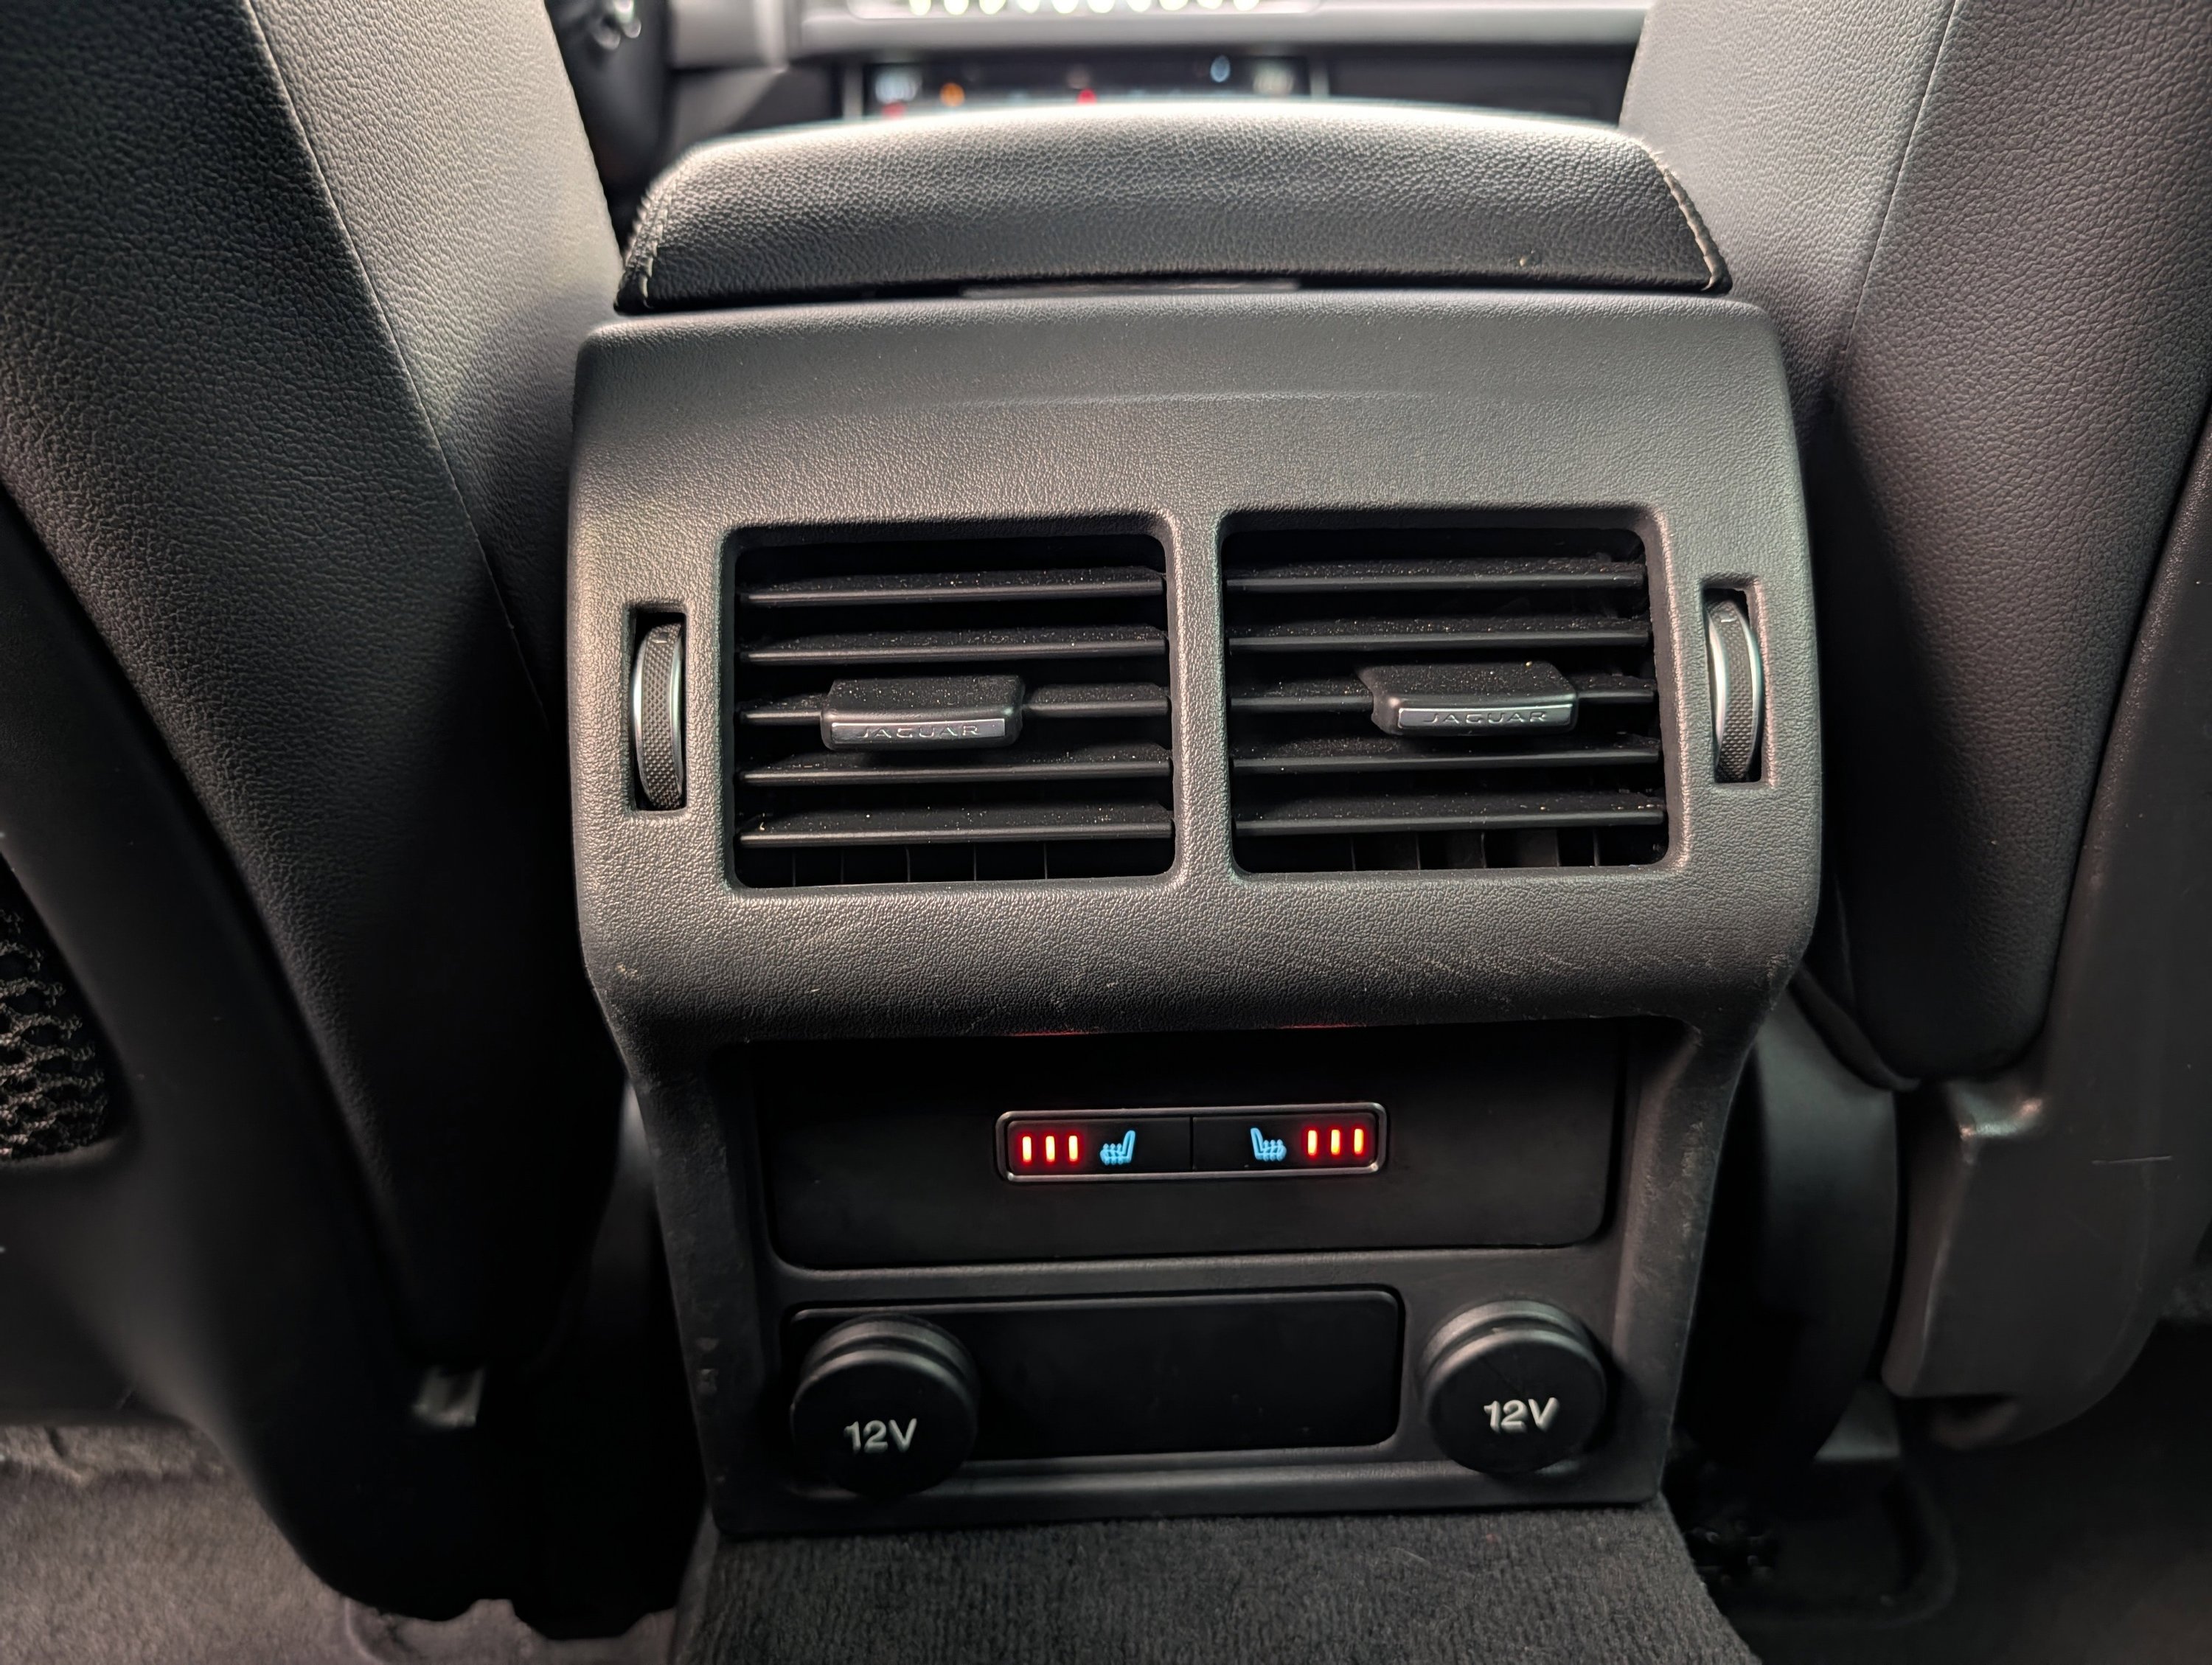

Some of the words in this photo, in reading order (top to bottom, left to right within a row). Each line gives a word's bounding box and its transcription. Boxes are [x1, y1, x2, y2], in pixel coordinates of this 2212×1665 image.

[1423, 710, 1547, 725] JAGUAR
[858, 726, 979, 738] JAGUAR
[1484, 1397, 1560, 1433] 12V
[844, 1417, 917, 1453] 12V
